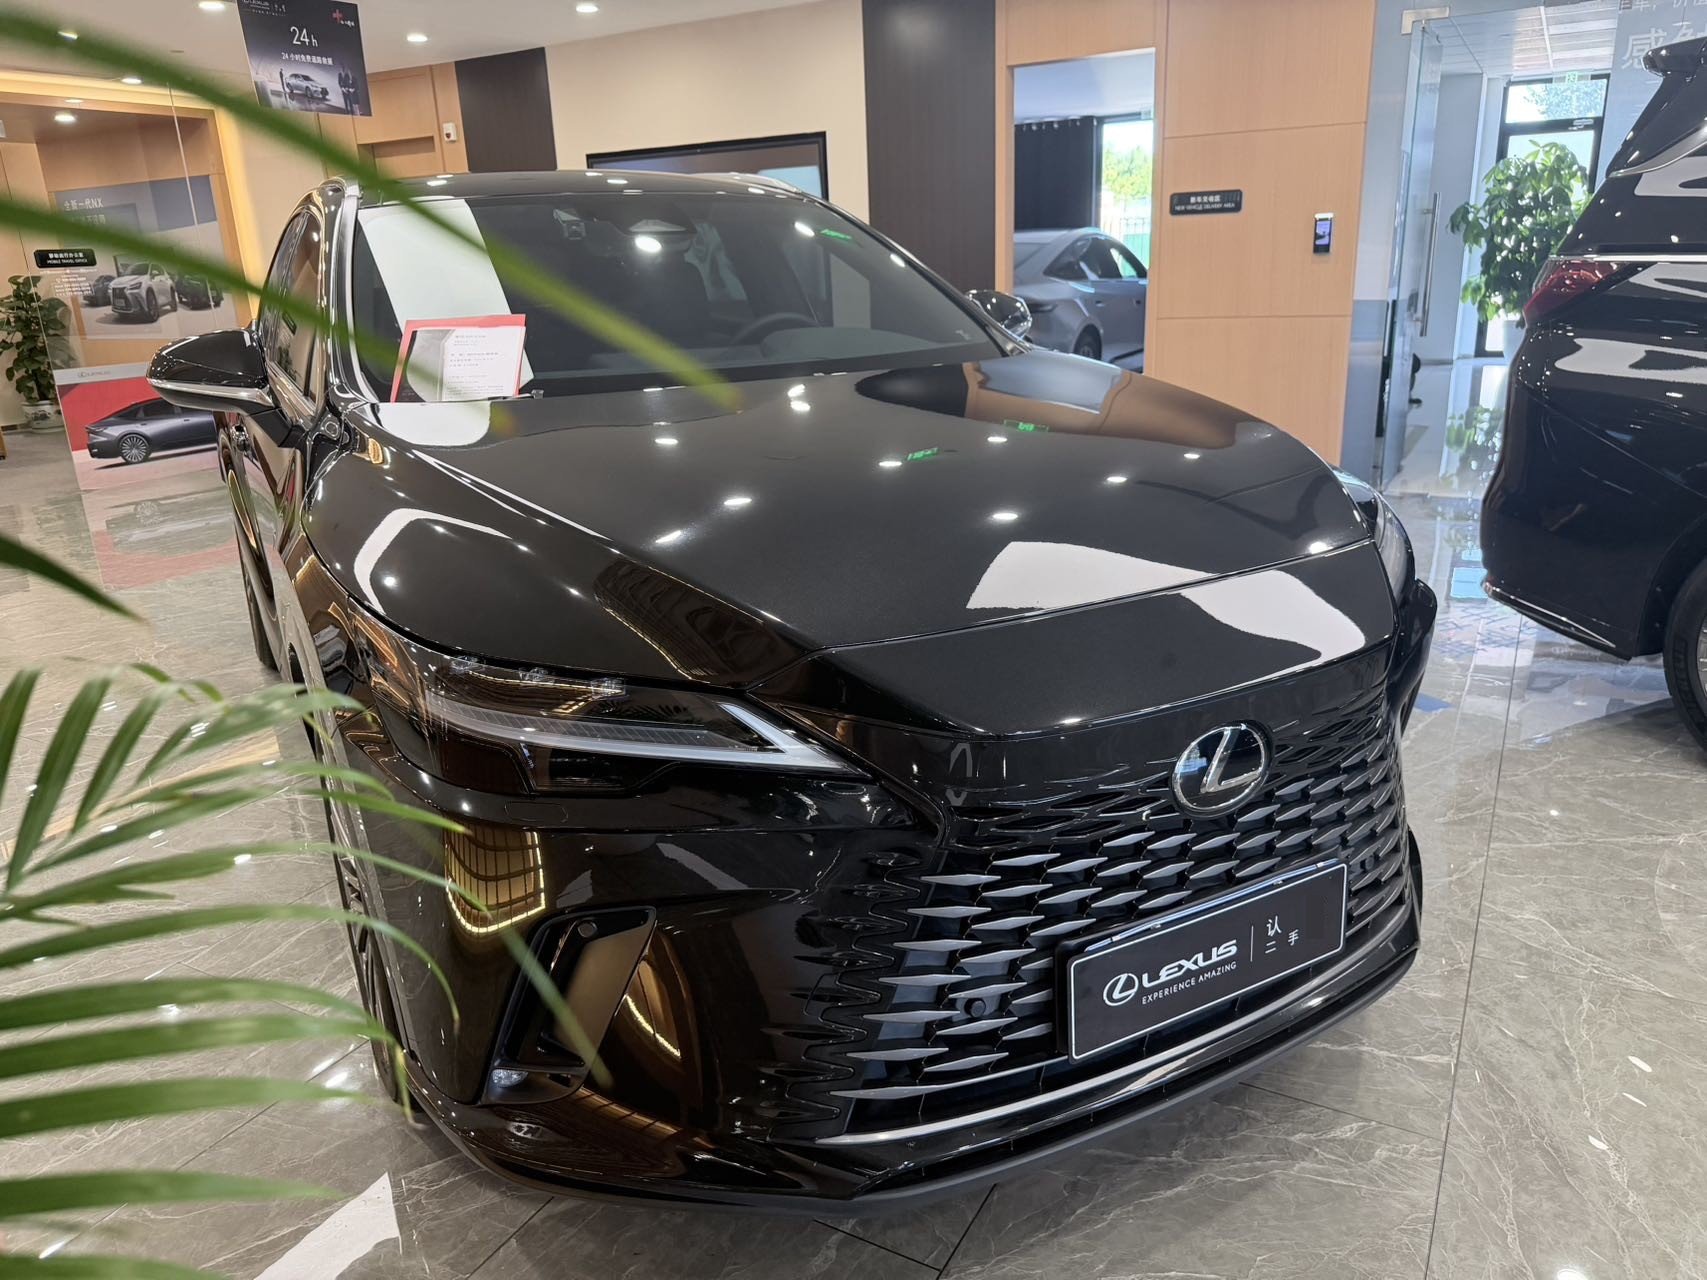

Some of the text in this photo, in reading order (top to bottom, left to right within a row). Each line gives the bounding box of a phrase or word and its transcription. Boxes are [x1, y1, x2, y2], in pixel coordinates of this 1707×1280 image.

[1141, 939, 1238, 989] LEXUS
[1142, 961, 1237, 1005] EXPERIENCE AMAZING
